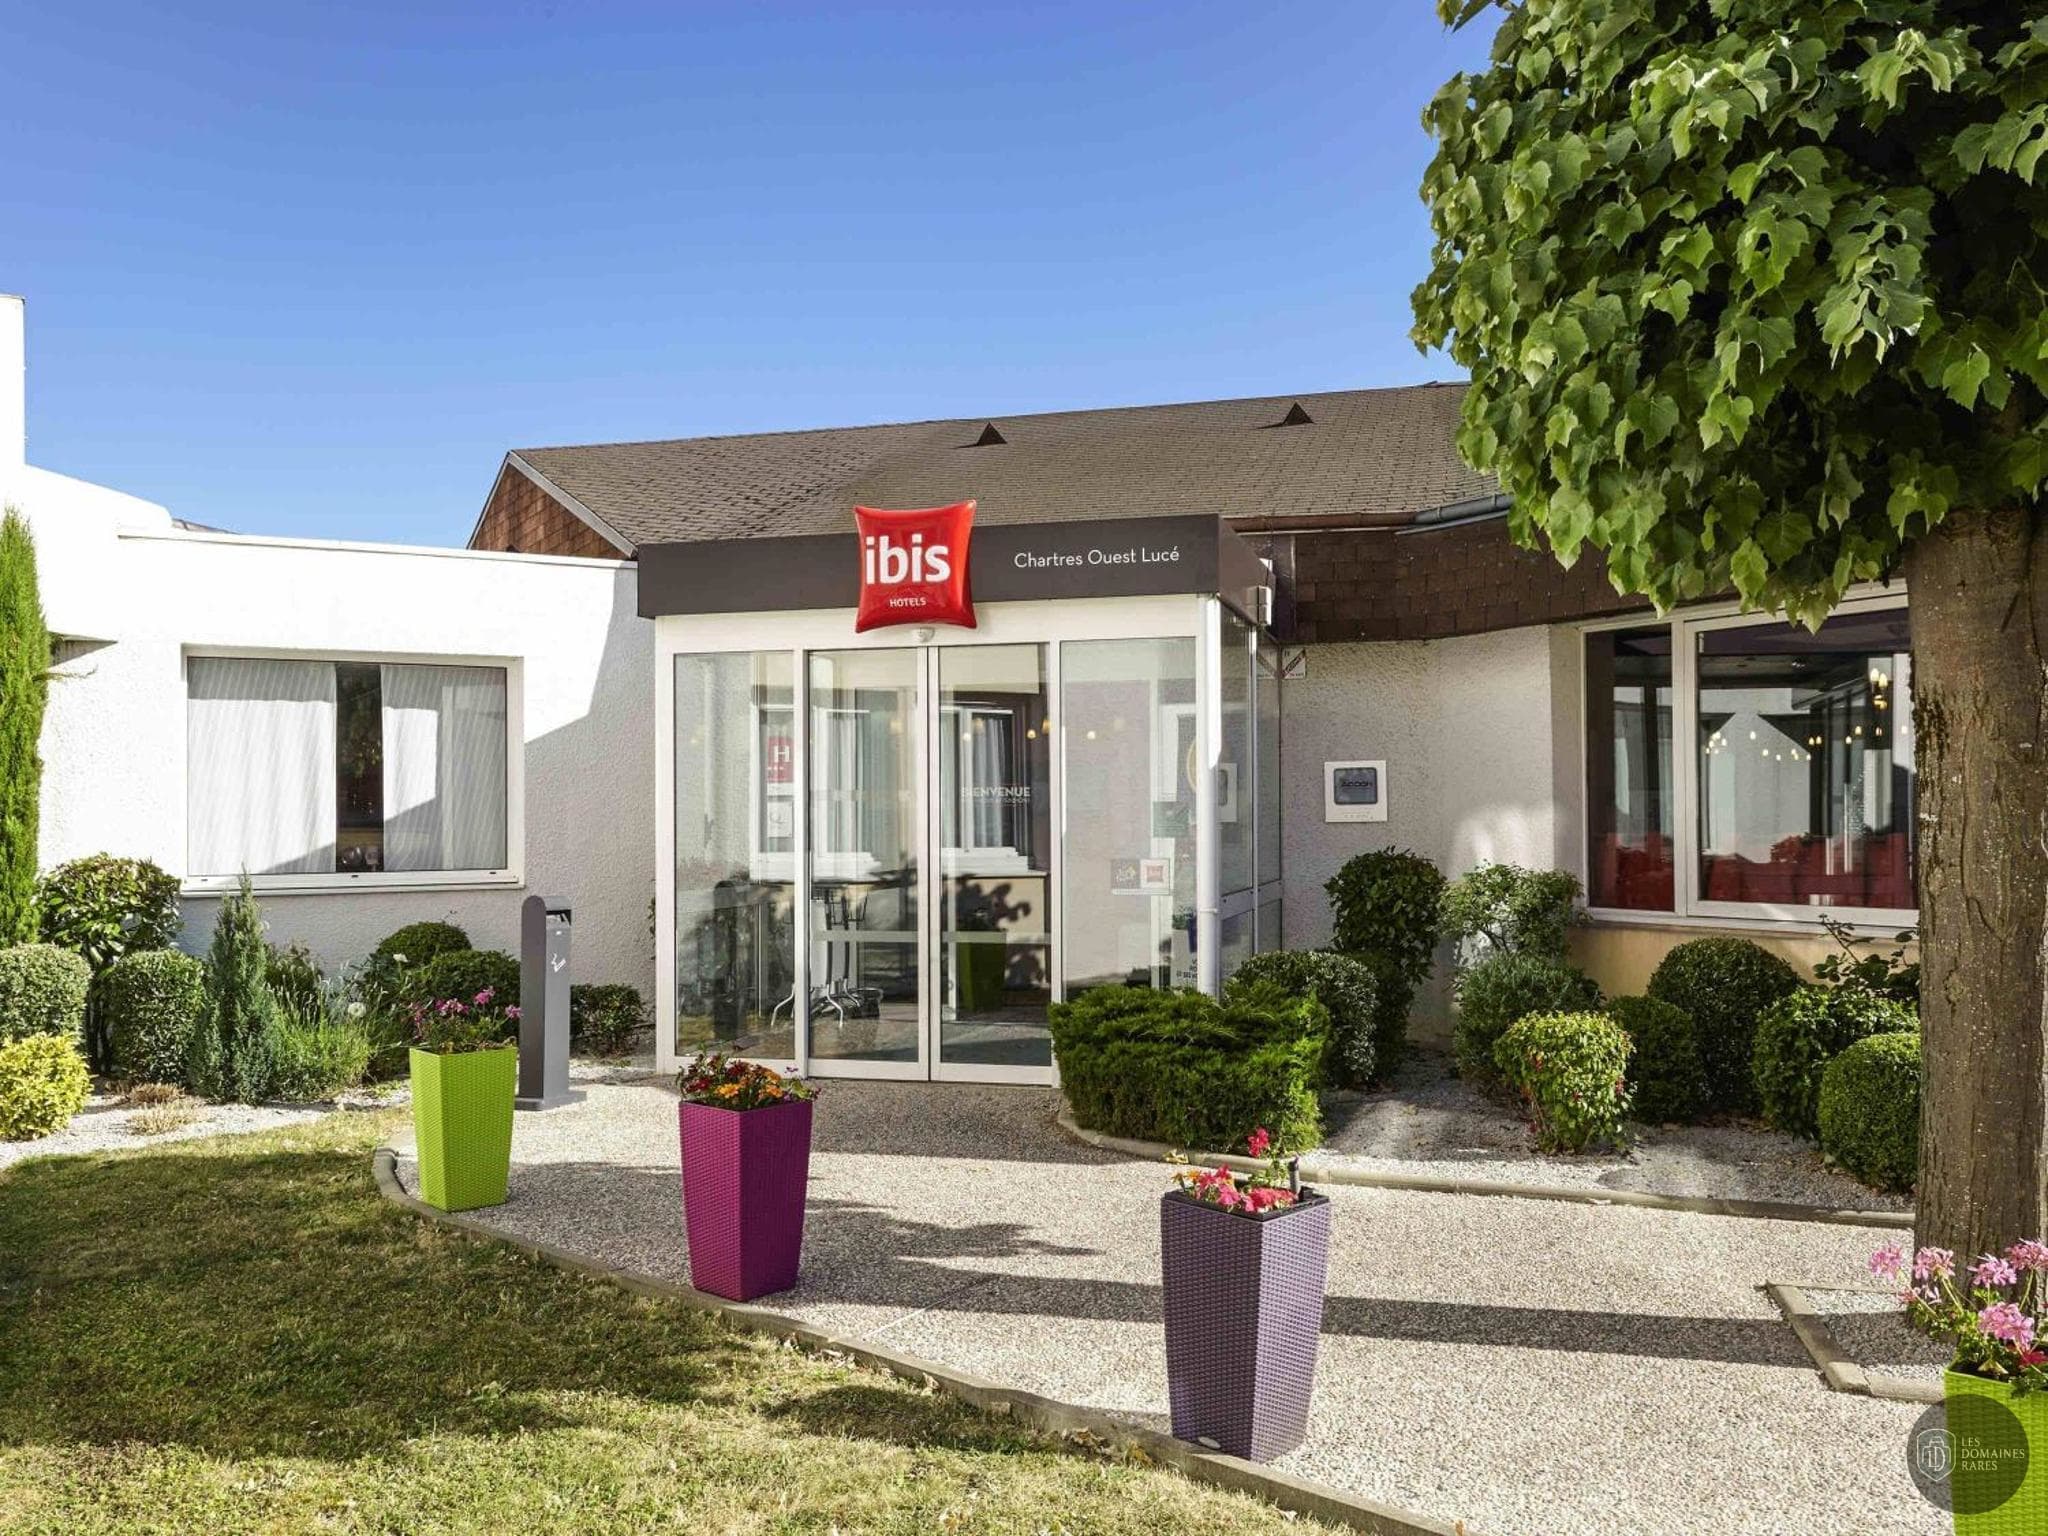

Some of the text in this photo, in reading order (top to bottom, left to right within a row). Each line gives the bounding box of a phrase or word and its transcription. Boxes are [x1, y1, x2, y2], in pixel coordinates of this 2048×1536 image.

[866, 533, 951, 585] ibis
[1014, 545, 1180, 568] Chartres Ouest Lucé
[889, 597, 927, 607] HOTELS
[773, 745, 790, 762] H
[961, 786, 1031, 797] BIENVENUE
